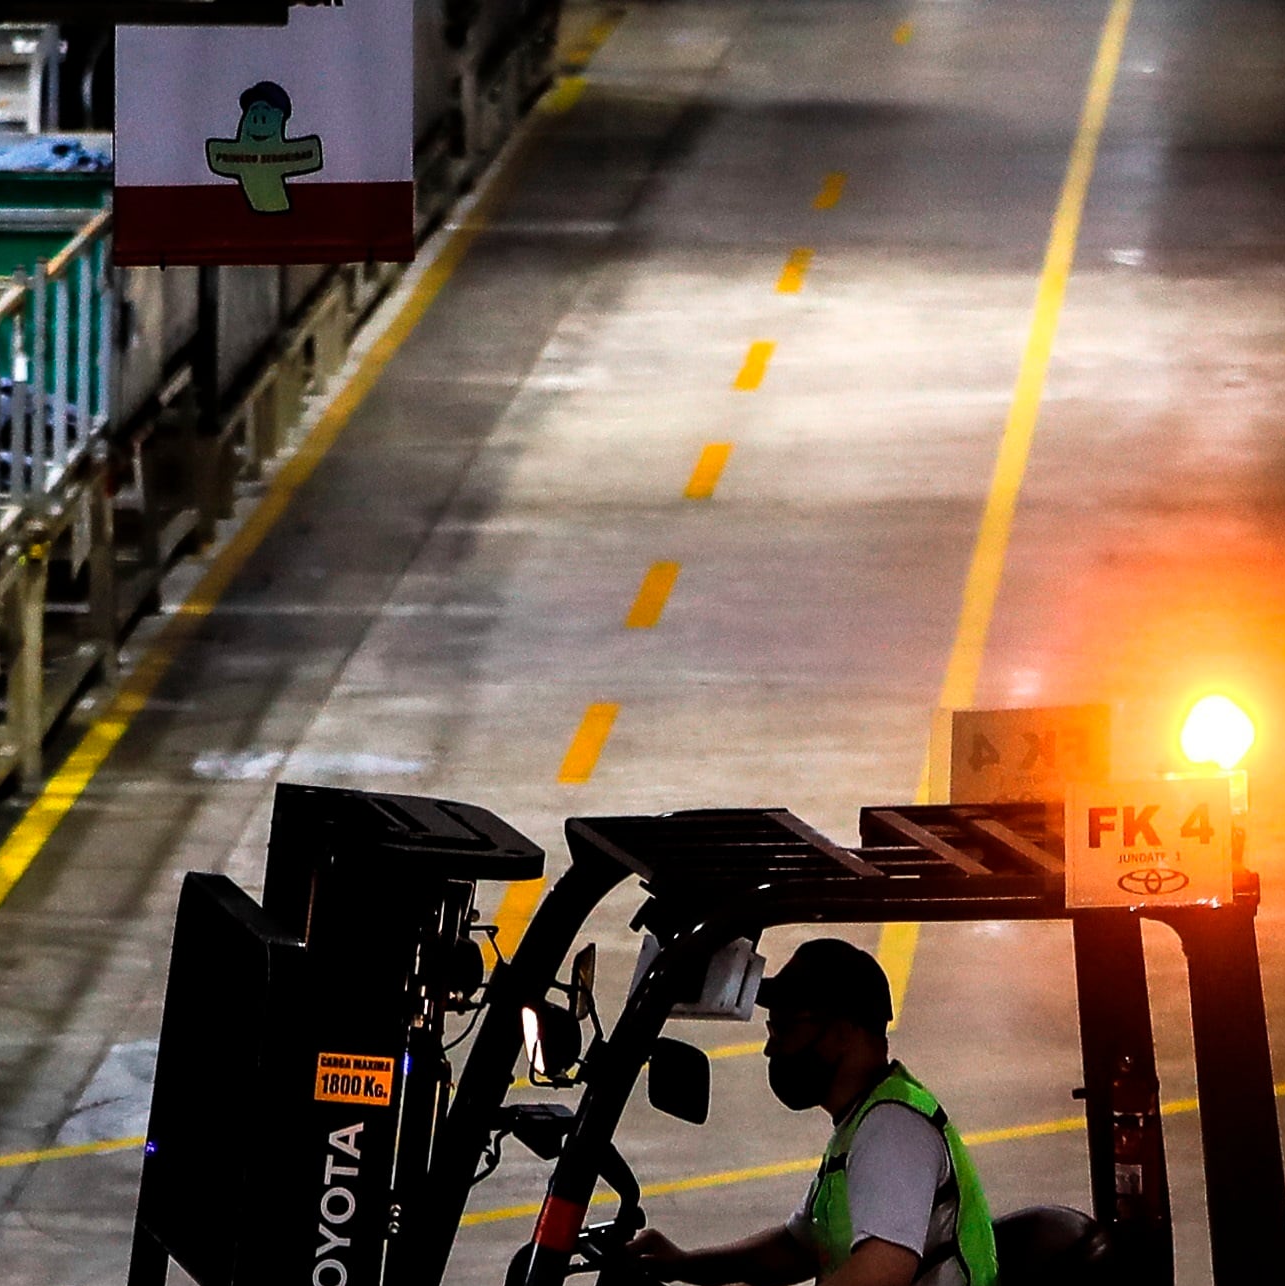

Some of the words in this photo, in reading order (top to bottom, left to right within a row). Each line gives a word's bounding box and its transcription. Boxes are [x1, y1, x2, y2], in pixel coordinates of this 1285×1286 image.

[1087, 805, 1163, 848] FK
[1180, 802, 1216, 845] 4
[321, 1056, 351, 1068] CARGA
[322, 1073, 362, 1095] 1800
